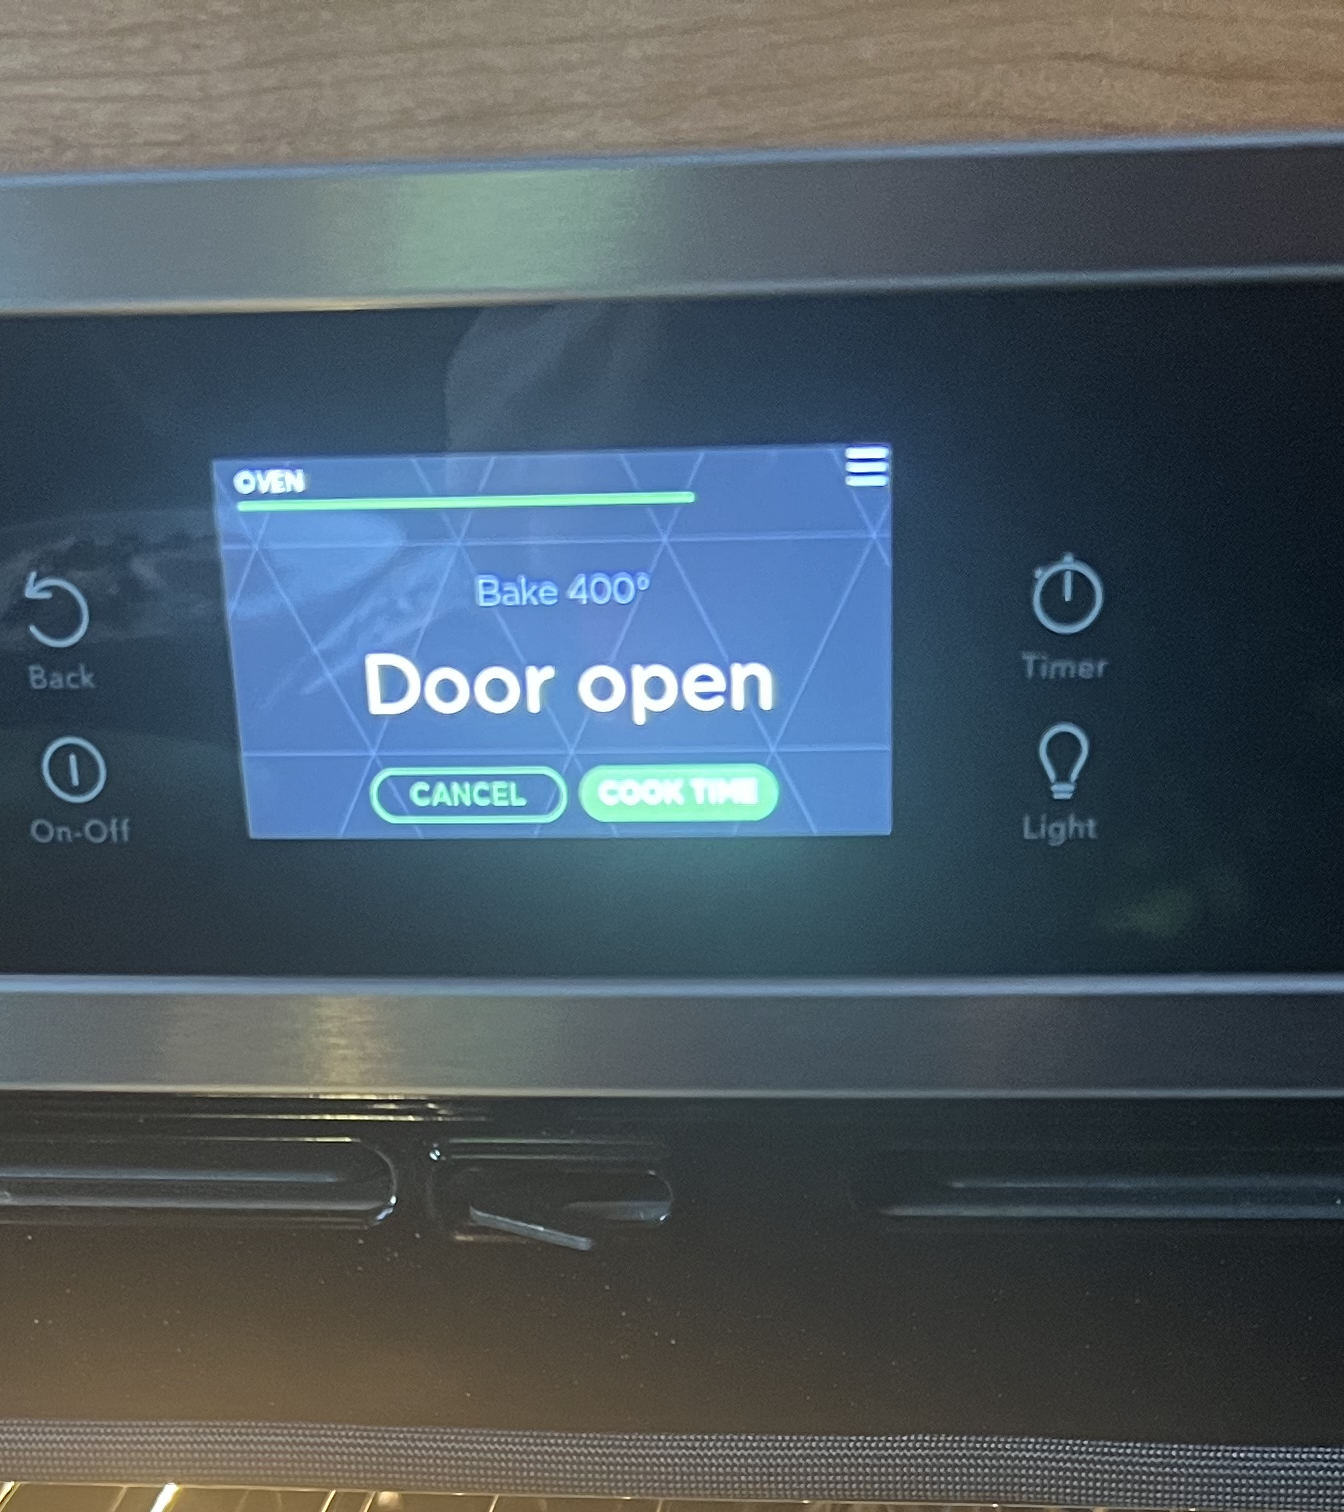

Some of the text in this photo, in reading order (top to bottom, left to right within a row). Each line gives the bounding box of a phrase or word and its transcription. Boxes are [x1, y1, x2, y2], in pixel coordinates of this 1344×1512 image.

[233, 468, 305, 494] OVEN
[476, 572, 650, 607] Bake 400°
[28, 664, 96, 690] Back
[1021, 651, 1109, 680] Timer
[364, 652, 774, 726] Door open
[409, 780, 527, 808] CANCEL
[597, 777, 759, 806] COOK TIME
[30, 817, 130, 844] On-Off
[1022, 813, 1098, 846] Light
